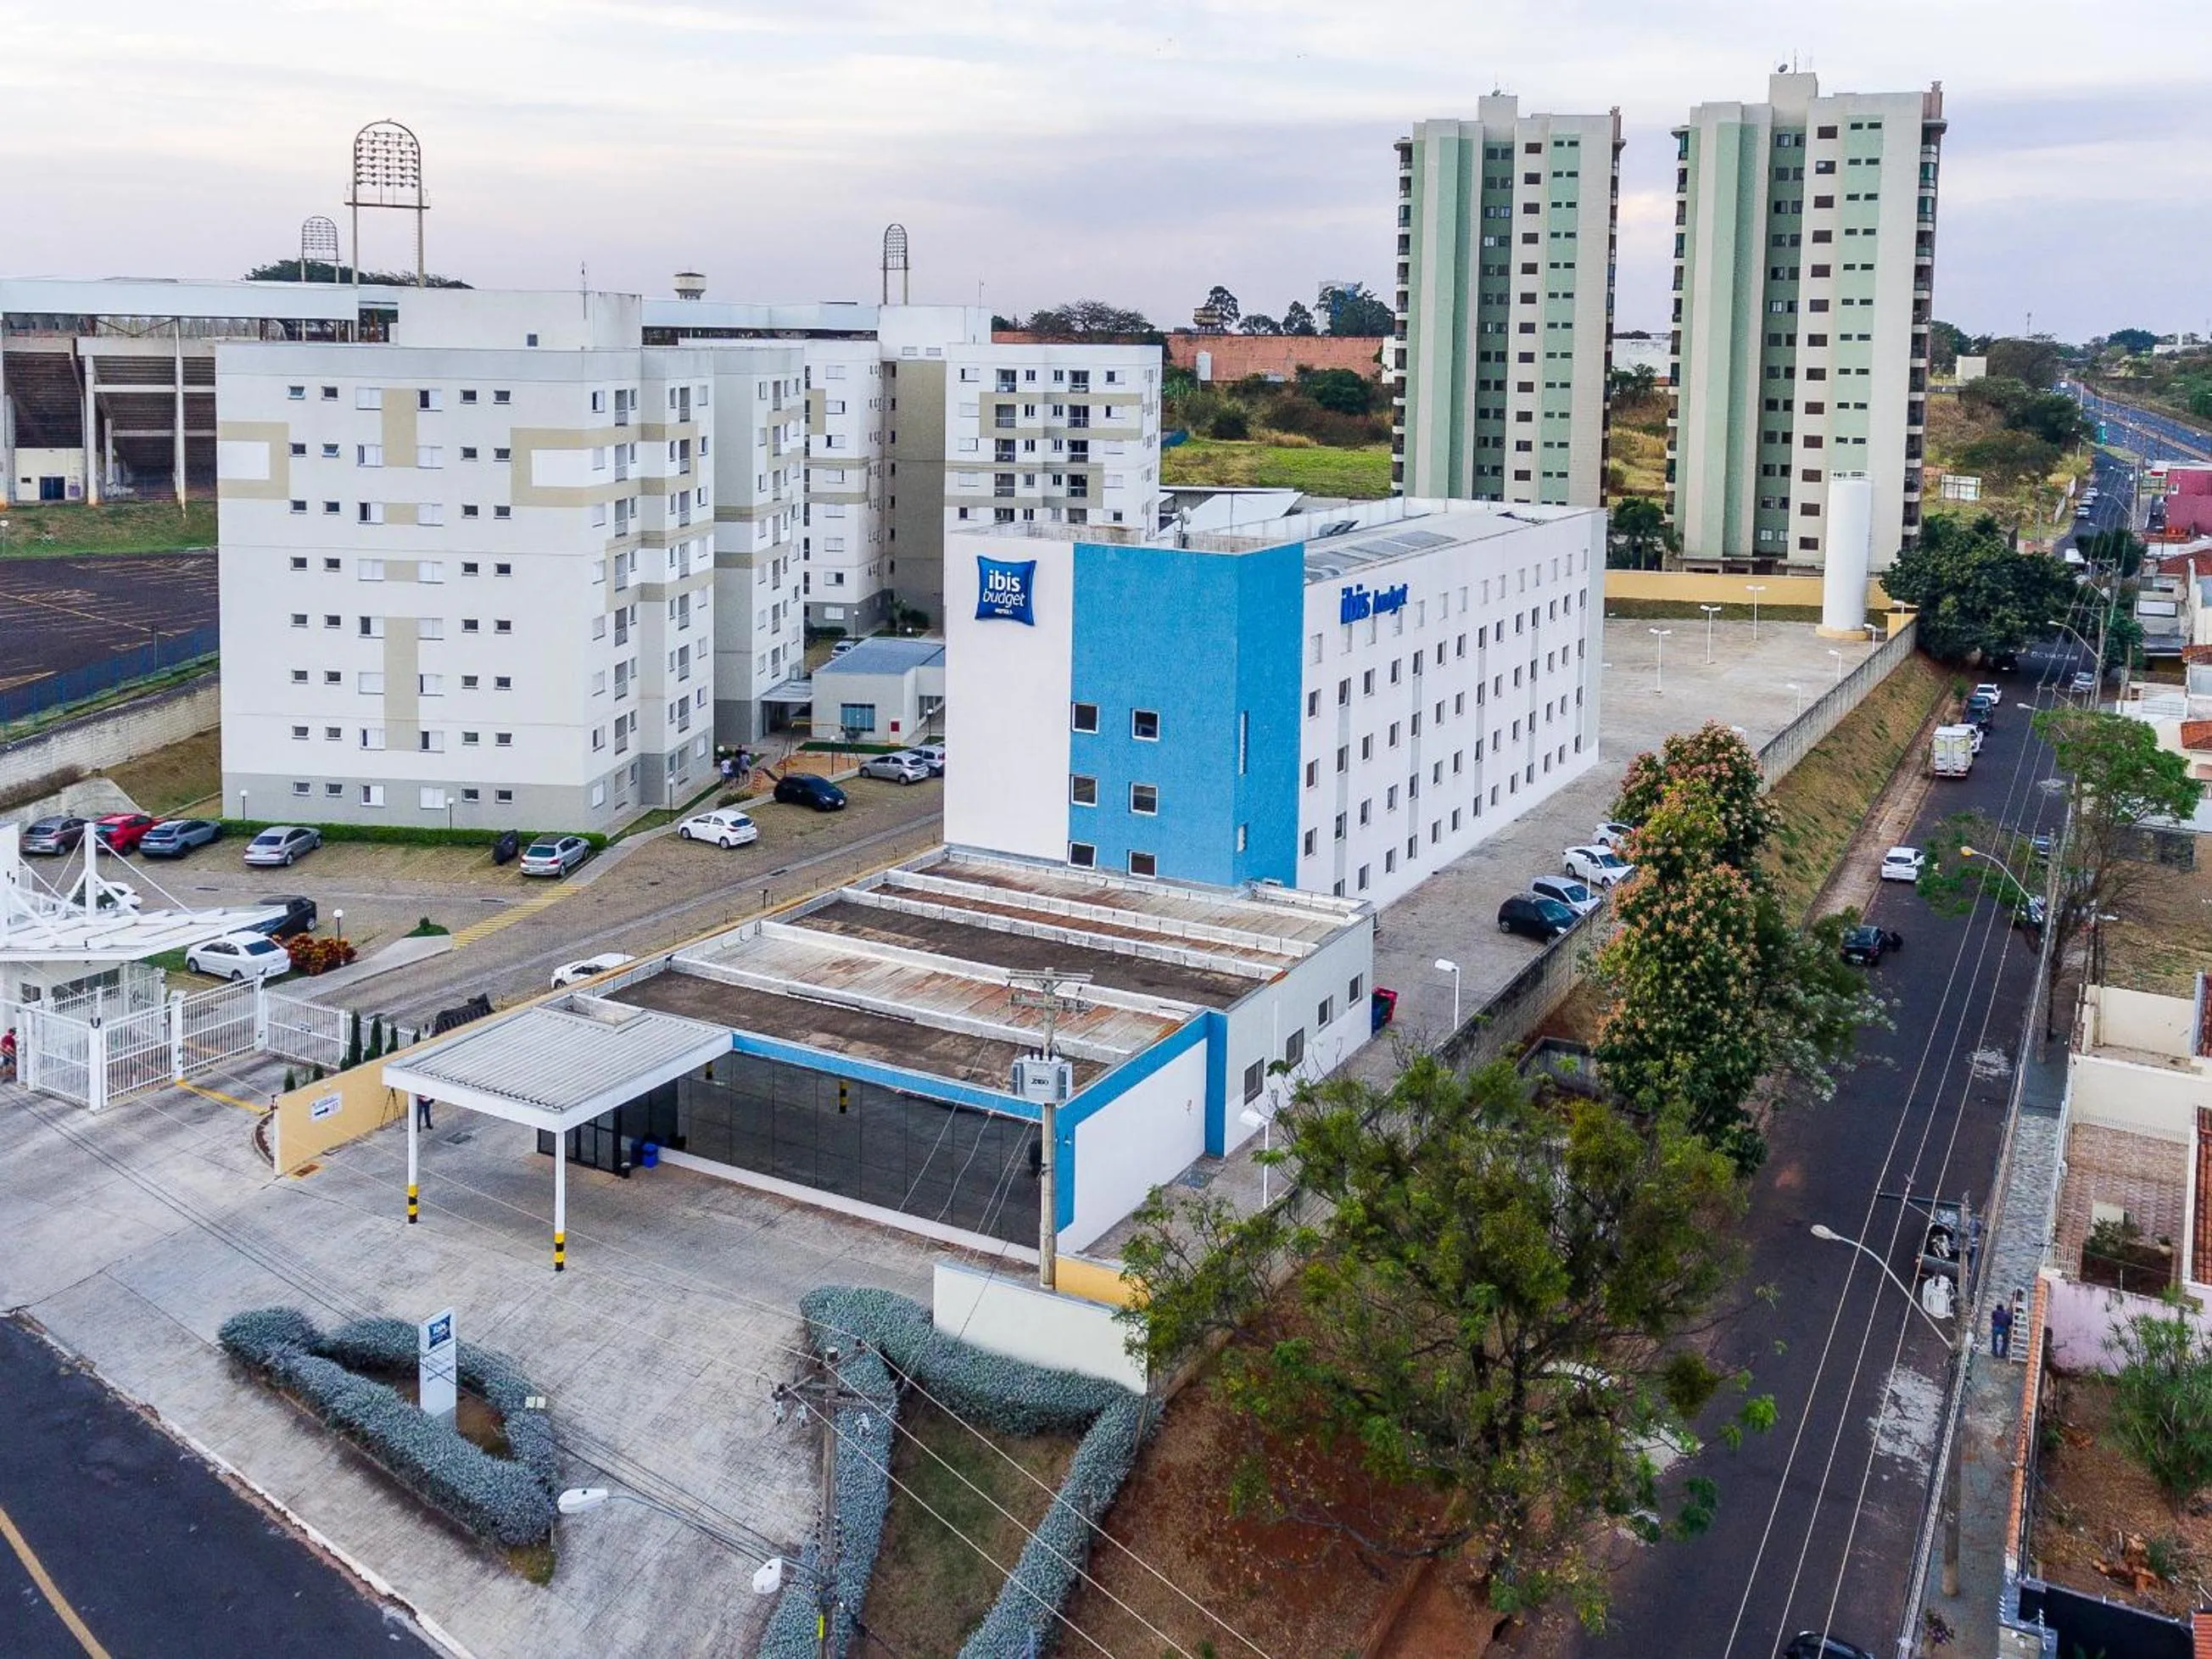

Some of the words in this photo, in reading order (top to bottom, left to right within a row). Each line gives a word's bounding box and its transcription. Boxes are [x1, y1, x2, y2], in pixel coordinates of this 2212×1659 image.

[988, 569, 1021, 592] ibis
[983, 588, 1025, 608] budget
[1341, 584, 1371, 624] ibis
